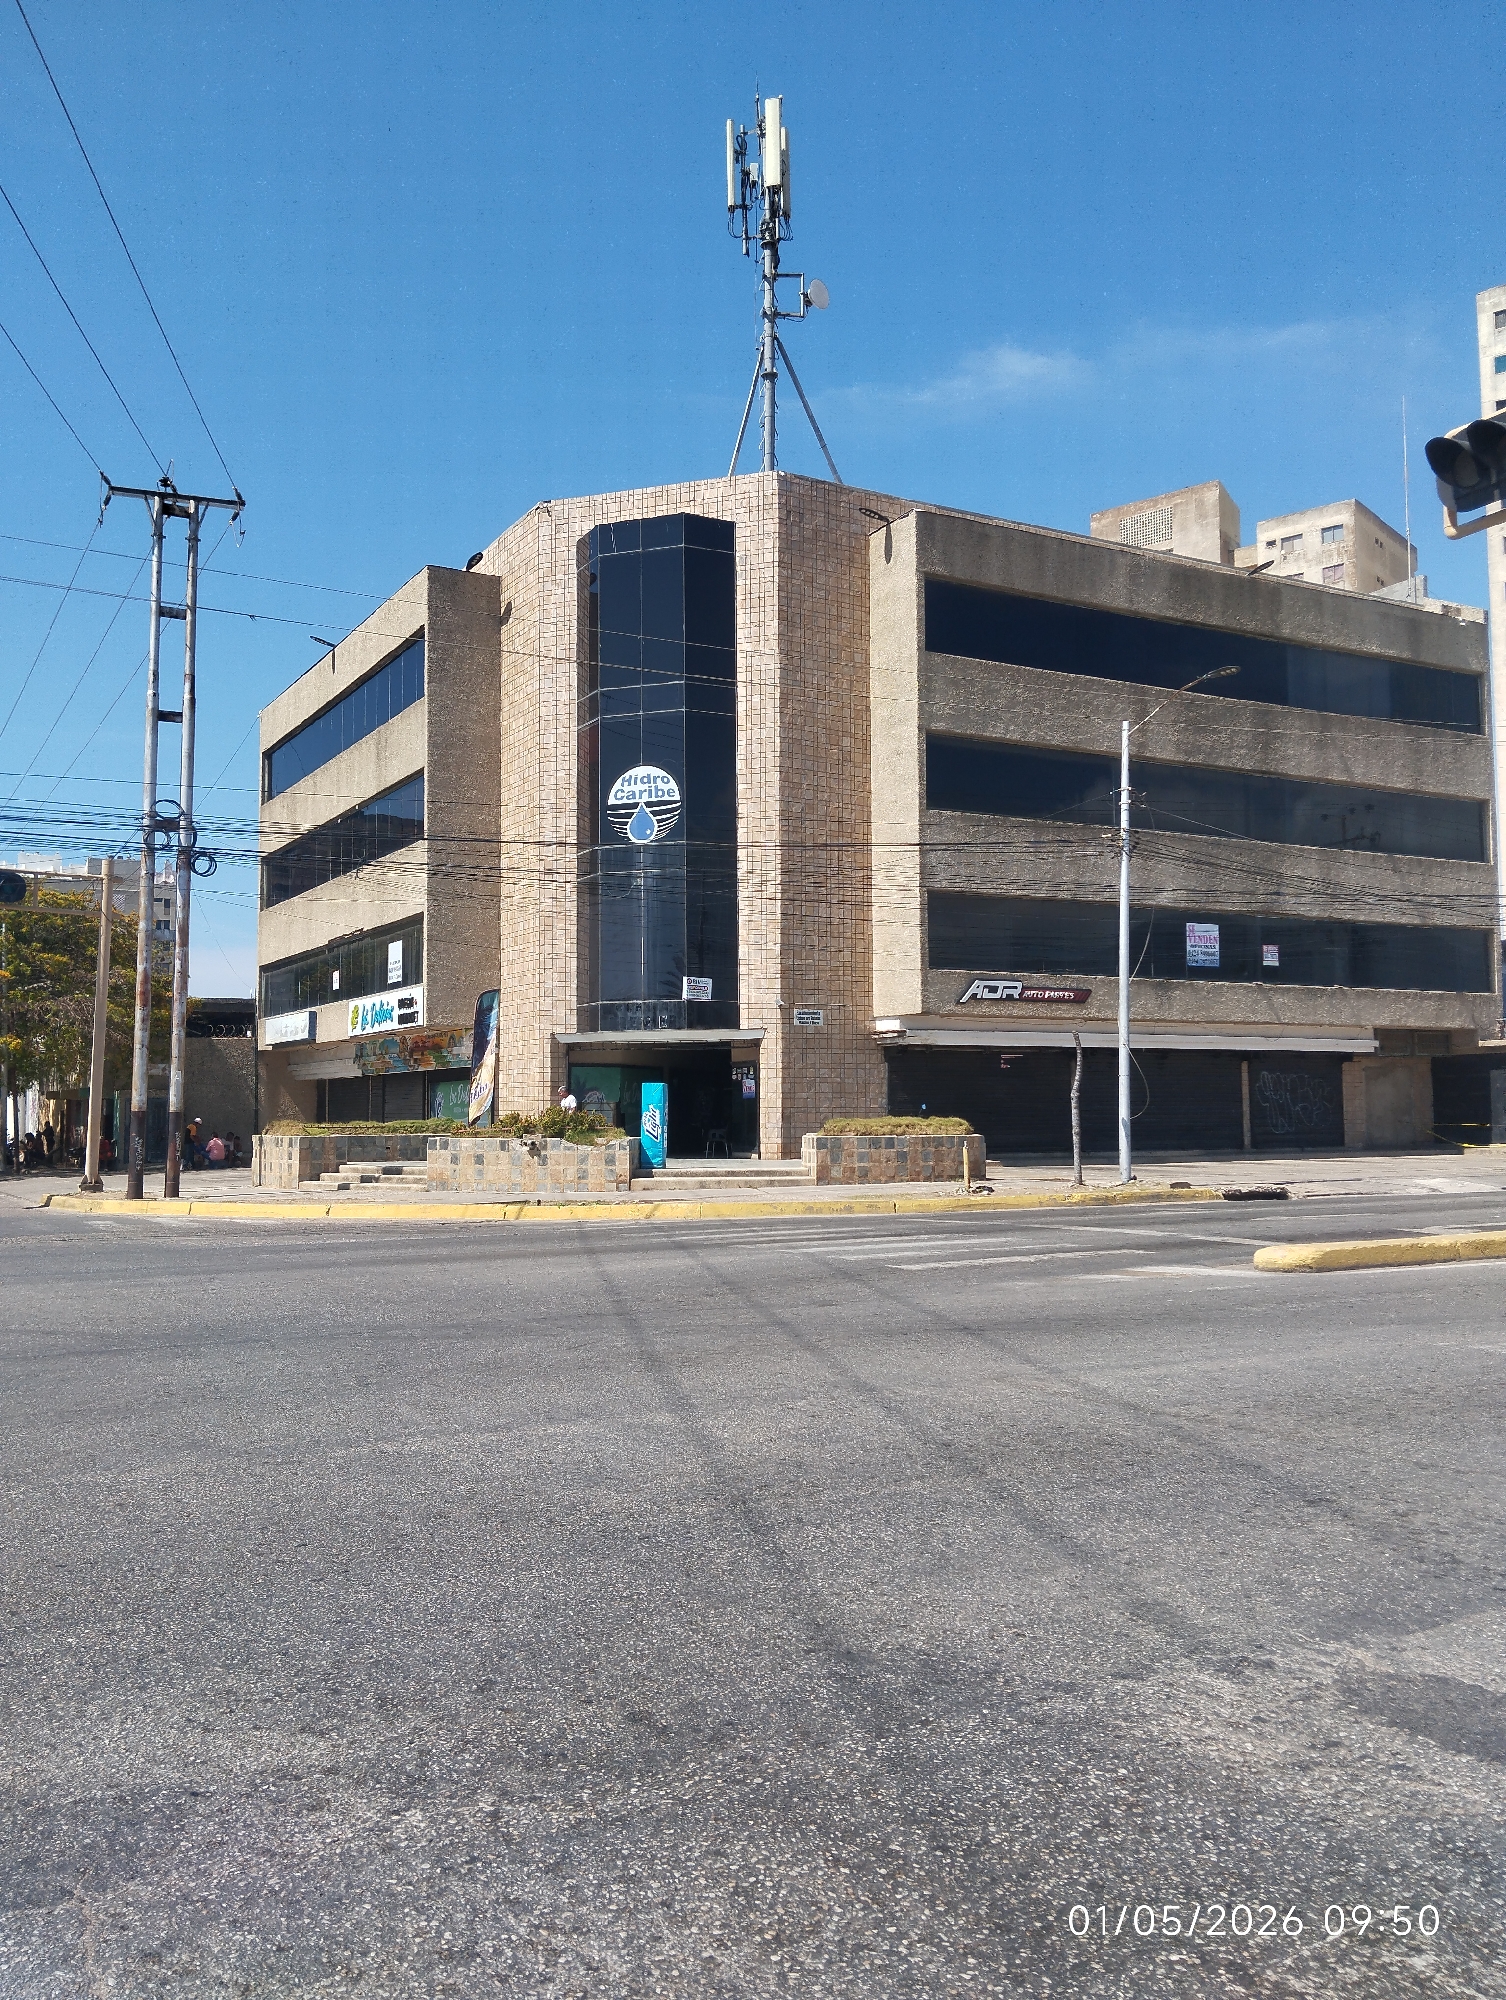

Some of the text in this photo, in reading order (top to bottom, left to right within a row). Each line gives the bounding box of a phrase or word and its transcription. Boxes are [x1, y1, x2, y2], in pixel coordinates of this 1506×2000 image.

[620, 773, 671, 788] Hidro
[613, 785, 676, 801] Caribe
[1188, 925, 1196, 935] SE
[1188, 934, 1219, 944] VENDEN
[960, 979, 1022, 1003] ADR
[1022, 990, 1075, 1000] AUTO PARTES
